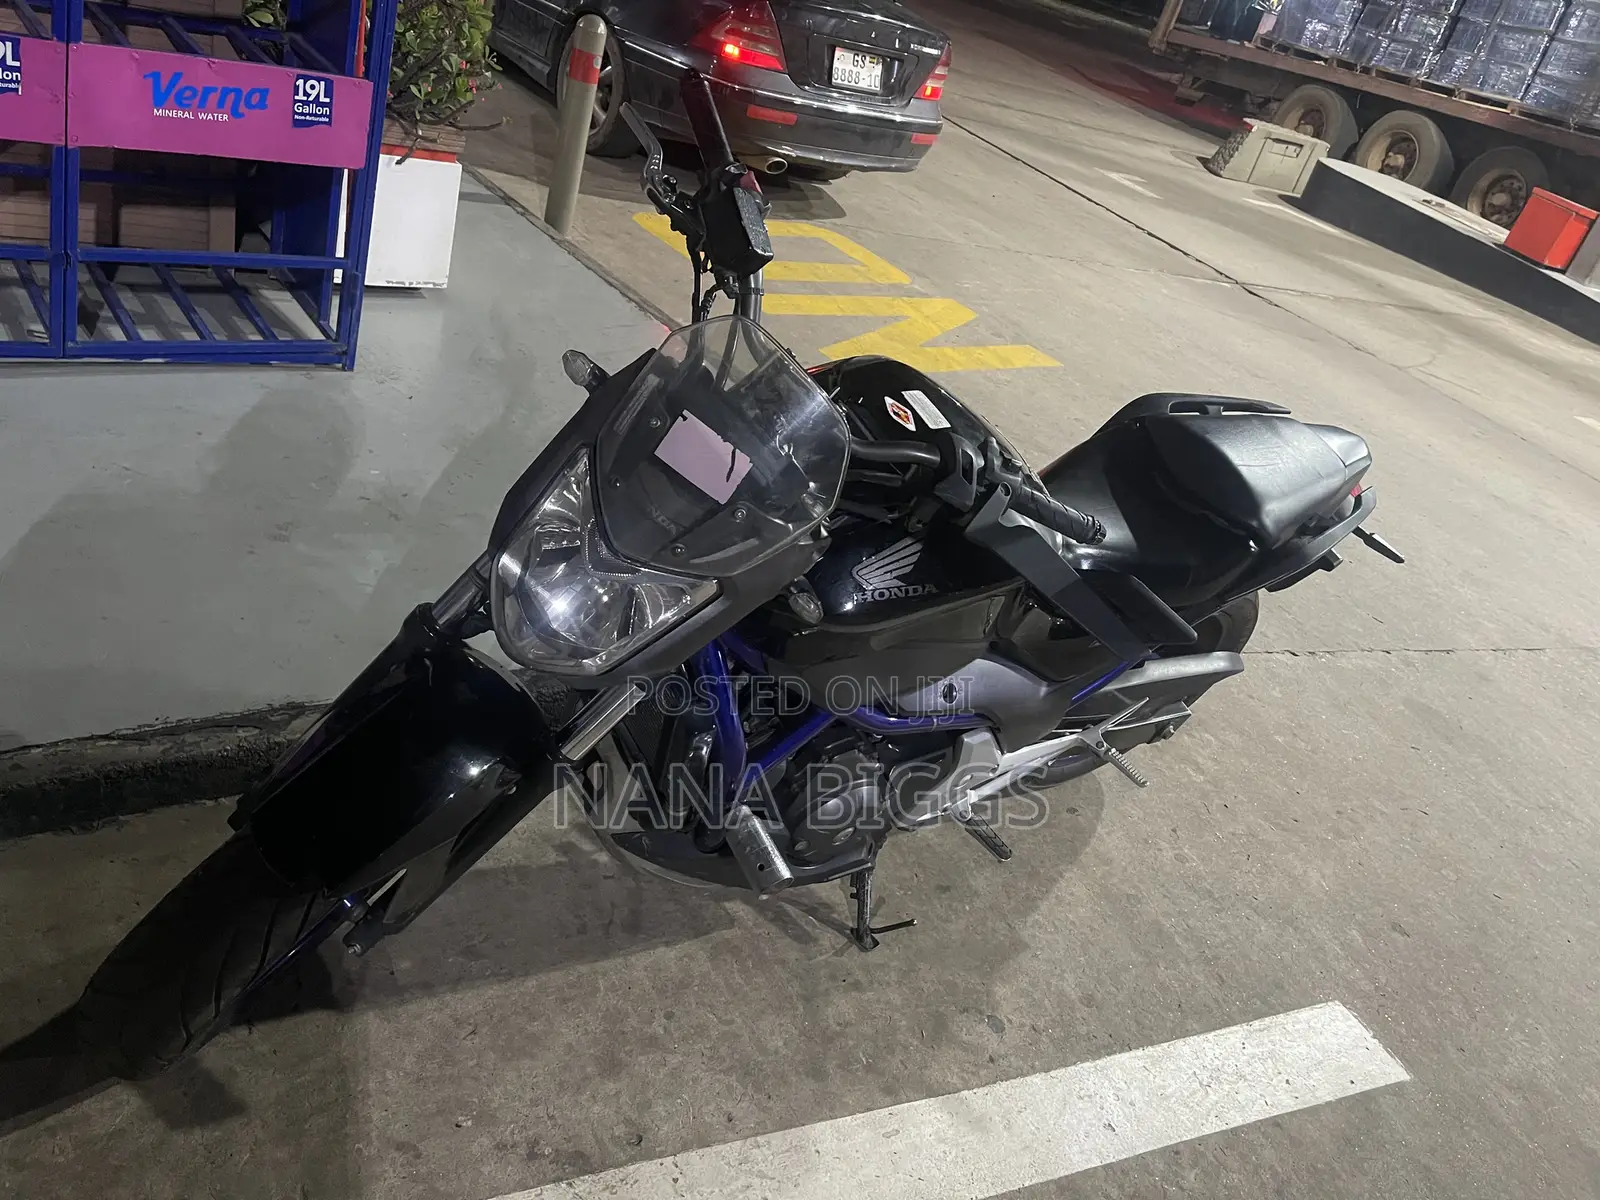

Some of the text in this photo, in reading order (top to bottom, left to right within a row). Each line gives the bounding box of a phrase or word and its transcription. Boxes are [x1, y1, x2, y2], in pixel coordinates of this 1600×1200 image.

[852, 53, 867, 70] GS
[143, 70, 270, 119] Verna
[294, 79, 330, 102] 19L
[153, 108, 229, 122] MINERAL WATER
[294, 102, 329, 115] Gallon
[853, 583, 939, 603] HONDA
